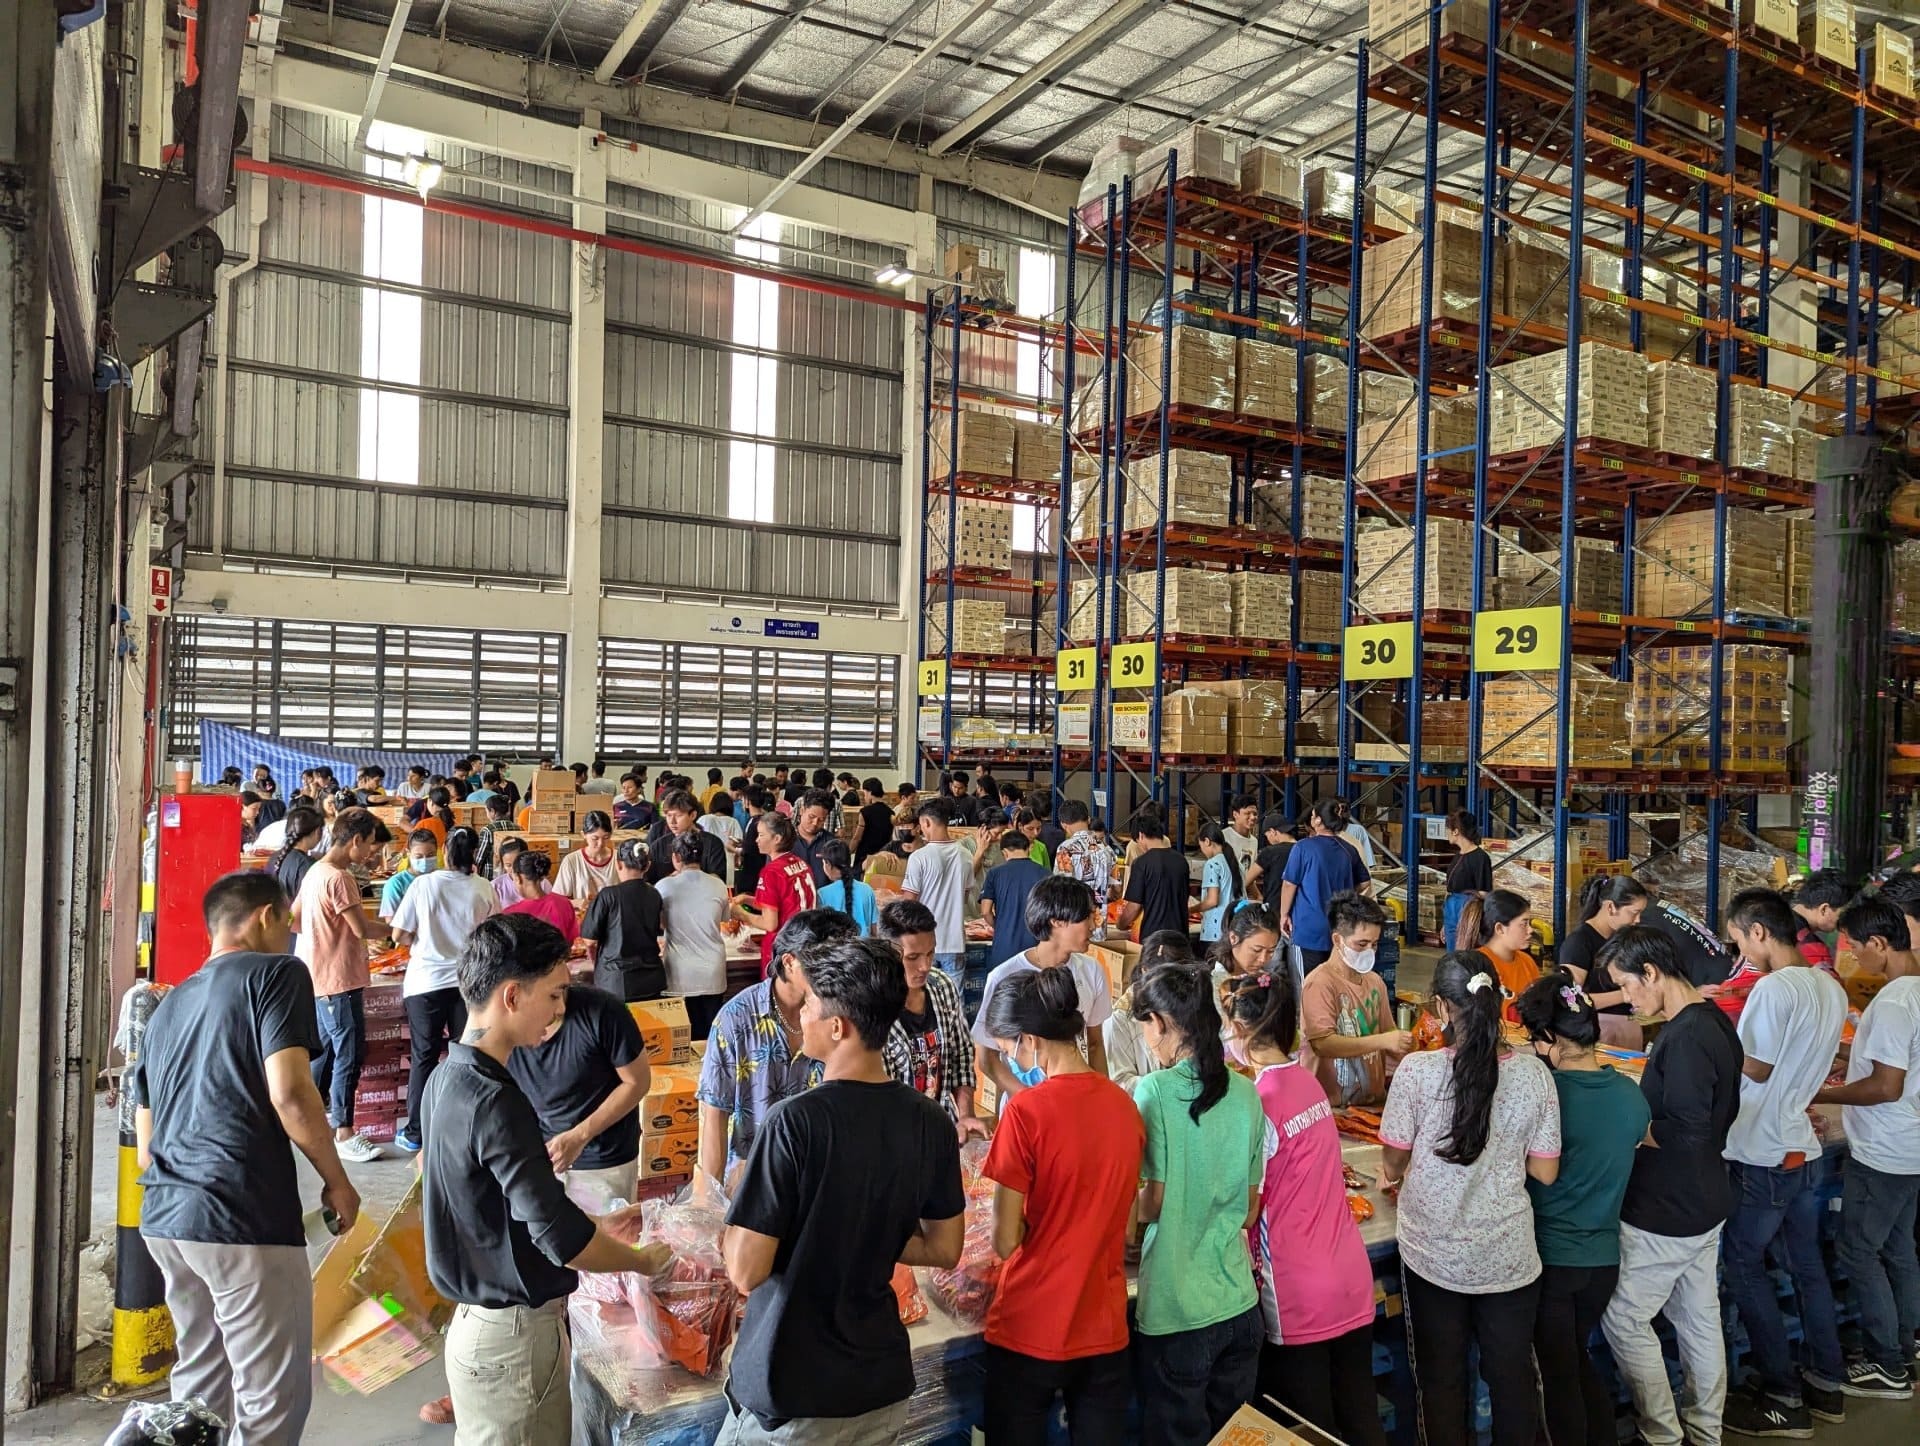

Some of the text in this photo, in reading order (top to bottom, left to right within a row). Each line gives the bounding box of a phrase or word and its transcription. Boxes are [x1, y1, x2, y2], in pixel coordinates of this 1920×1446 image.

[1495, 625, 1538, 654] 29
[1361, 638, 1396, 665] 30
[1068, 659, 1084, 679] 31
[1122, 655, 1144, 675] 30
[926, 670, 938, 686] 31
[795, 872, 817, 910] 11
